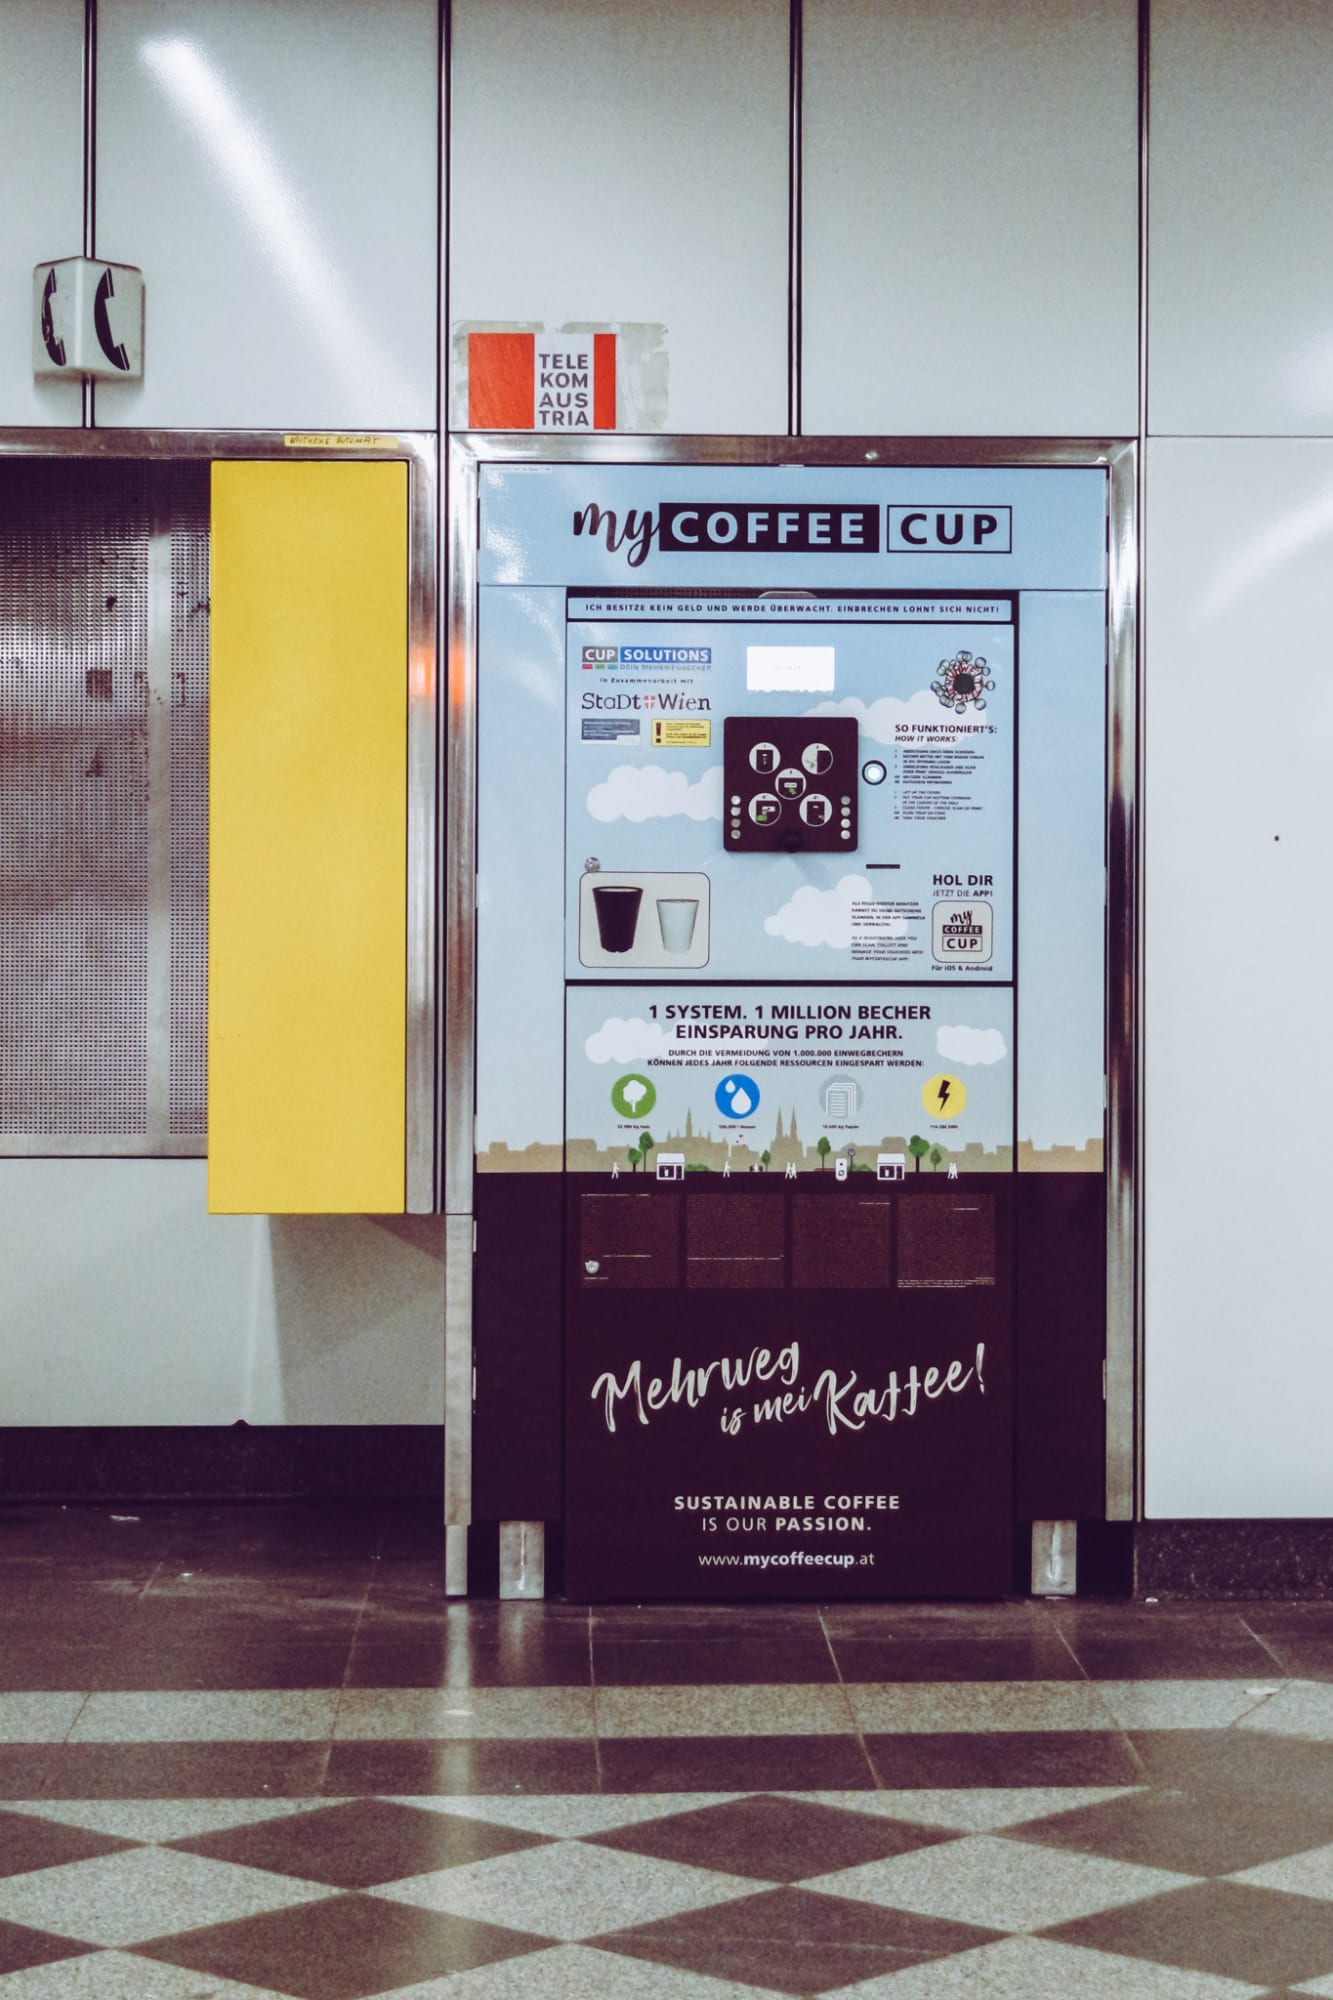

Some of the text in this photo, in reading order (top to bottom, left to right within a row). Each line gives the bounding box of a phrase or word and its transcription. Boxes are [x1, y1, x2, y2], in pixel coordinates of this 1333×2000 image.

[539, 354, 589, 369] TELE
[541, 373, 588, 388] KOM
[539, 392, 588, 408] AUS
[539, 410, 589, 426] TRIA
[573, 502, 998, 568] my COFFEE CUP
[585, 603, 999, 613] ICH BESITZE KEIN GELD UND WERDE ÜBERWACHT. EINBRECHEN LOHNT SICH NICHT!
[585, 649, 709, 661] CUP SOLUTIONS
[658, 692, 712, 711] Wien
[894, 724, 998, 734] SO FUNKTIONIERT'S:
[926, 735, 956, 743] WORKS
[933, 874, 993, 886] HOL DIR
[932, 889, 954, 897] JETZT
[950, 909, 973, 927] my
[946, 938, 978, 949] CUP
[649, 1005, 931, 1020] 1 SYSTEM. 1 MILLION BECHER
[676, 1025, 903, 1039] EINSPARUNG PRO JAHR.
[647, 1058, 683, 1067] KÖNNEN
[685, 1059, 709, 1067] JEDES
[711, 1059, 732, 1067] JAHR
[734, 1059, 778, 1067] FOLGENDE
[780, 1059, 833, 1067] RESSOURCEN
[835, 1059, 885, 1067] EINGESPART
[590, 1341, 800, 1434] Mehrweg
[720, 1406, 746, 1436] is
[813, 1342, 986, 1436] Kaffee!
[674, 1495, 900, 1510] SUSTAINABLE COFFEE
[702, 1517, 872, 1531] IS OUR PASSION.
[698, 1551, 875, 1569] www.mycoffeecup.at
